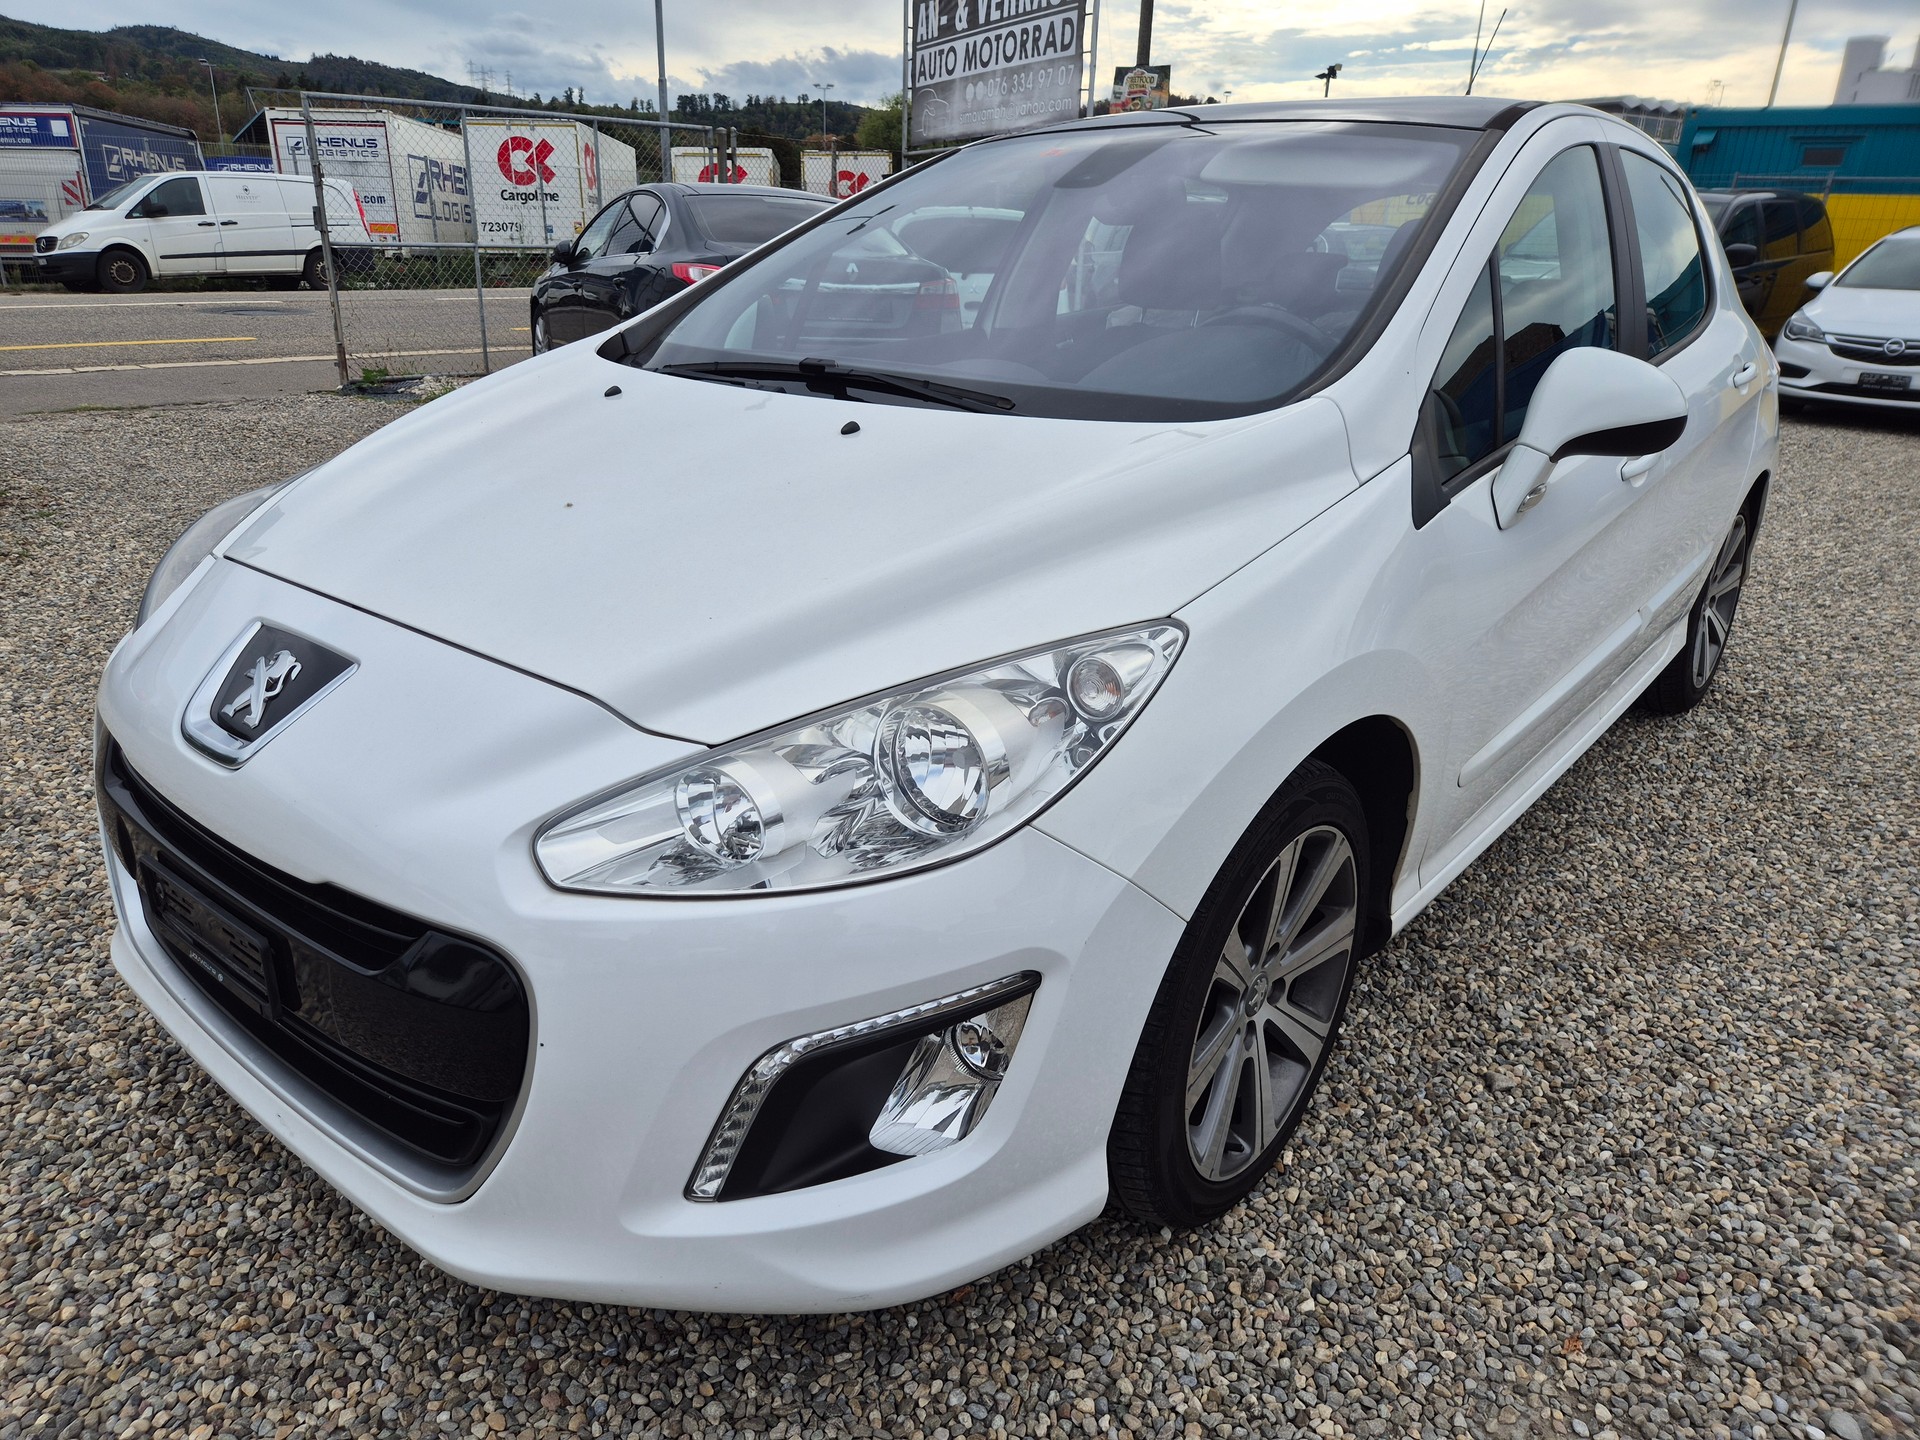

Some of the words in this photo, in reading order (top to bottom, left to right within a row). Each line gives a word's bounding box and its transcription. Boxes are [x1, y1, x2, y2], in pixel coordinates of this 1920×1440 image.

[917, 1, 948, 42] AN-
[955, 0, 969, 31] &
[917, 45, 957, 83] AUTO
[963, 16, 1075, 73] MOTORRAD
[986, 77, 1008, 97] 076
[1011, 71, 1033, 94] 334
[1038, 67, 1053, 89] 97
[1058, 64, 1075, 86] 07
[121, 147, 187, 172] RHENUS
[500, 189, 560, 205] Cargolne
[481, 221, 522, 233] 723079
